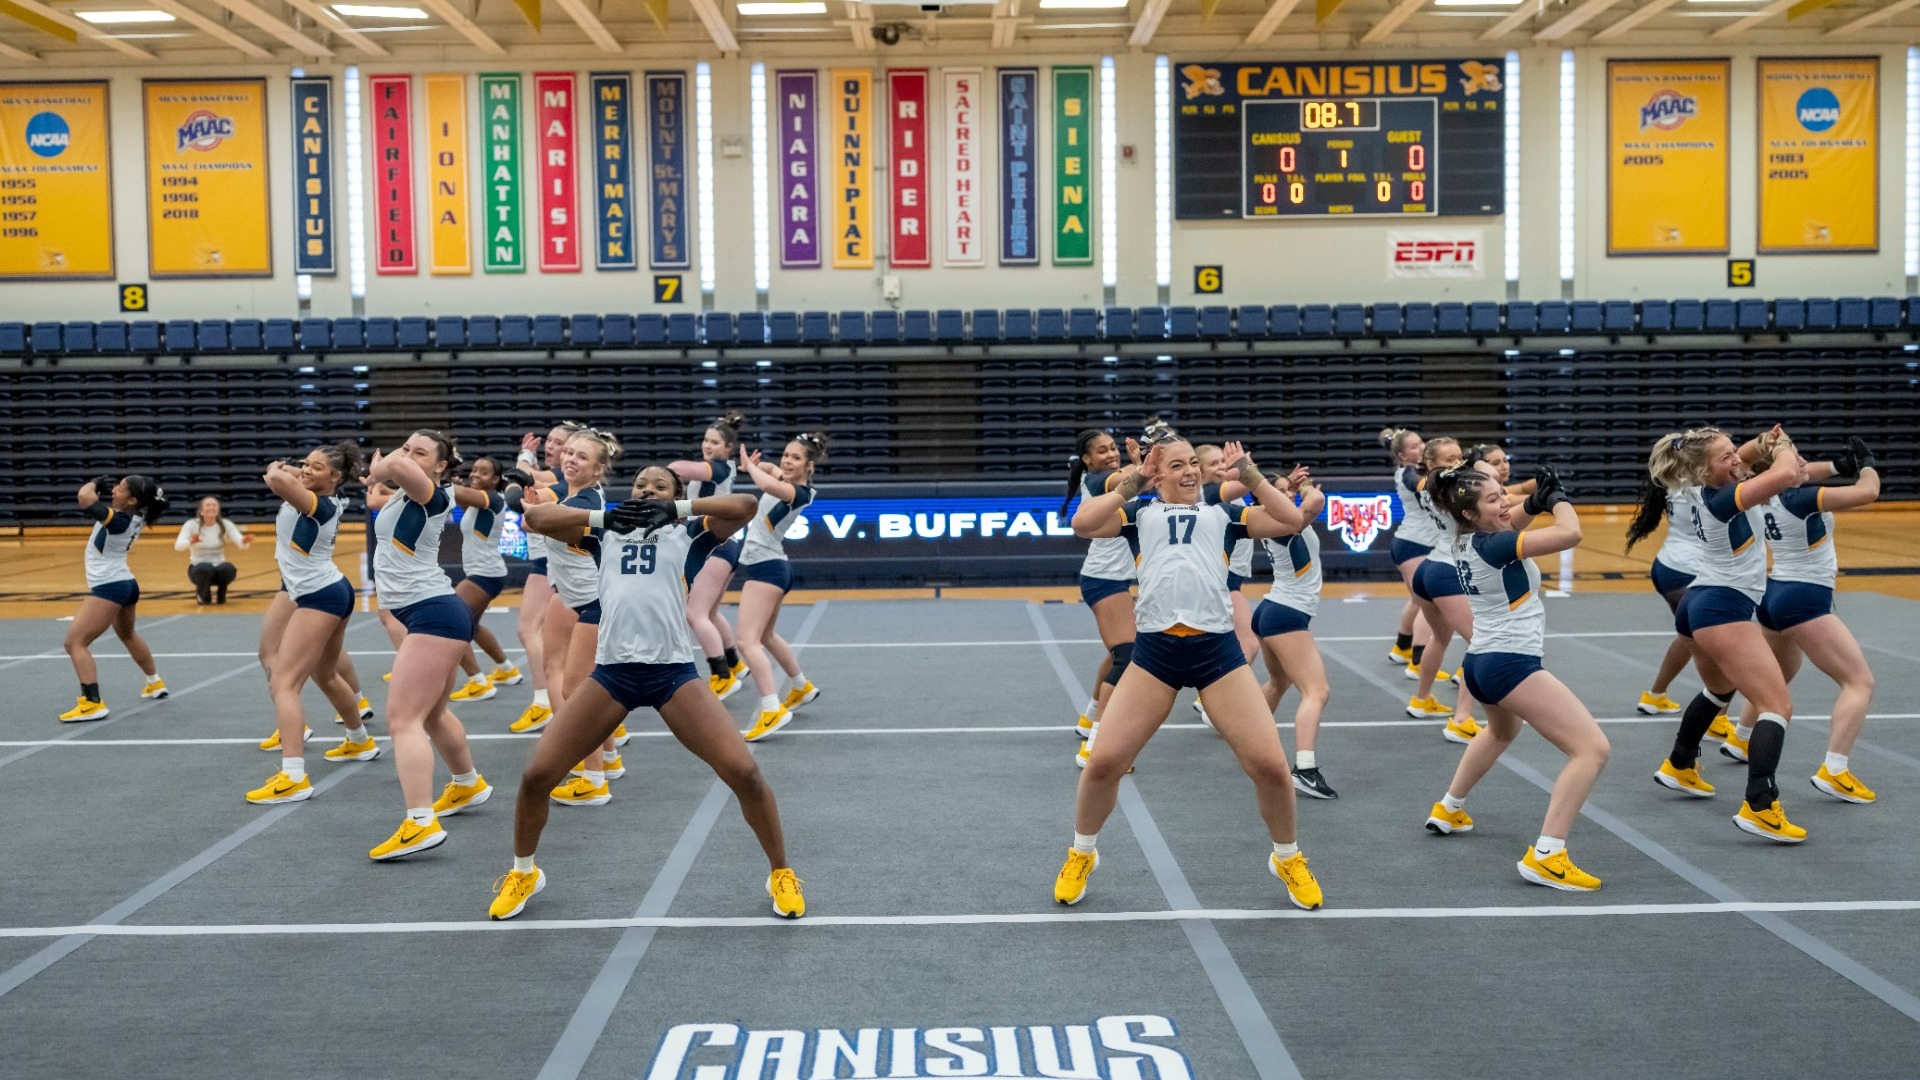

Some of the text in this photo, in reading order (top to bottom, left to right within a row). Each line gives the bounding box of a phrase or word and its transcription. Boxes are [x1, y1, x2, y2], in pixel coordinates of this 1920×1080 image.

[1237, 64, 1447, 96] CANISIUS
[656, 81, 676, 160] MOUNT
[1304, 102, 1359, 128] 08.7
[1641, 97, 1695, 129] MAAC
[1800, 108, 1839, 122] NCAA
[30, 133, 69, 147] NCAA
[177, 118, 232, 150] MAAC
[1252, 132, 1301, 145] CANISIUS
[1387, 131, 1422, 143] GUEST
[789, 94, 810, 245] NIAGARA
[844, 79, 862, 257] QUINNIPIAC
[899, 101, 919, 236] RIDER
[955, 79, 971, 255] SACRED HEART
[1009, 76, 1028, 257] SAINT PETERS
[1062, 98, 1084, 234] SIENA
[1280, 147, 1296, 173] 0
[1341, 150, 1348, 168] 1
[1408, 145, 1424, 171] 0
[1623, 155, 1663, 165] 2005
[2, 179, 36, 189] 1955
[162, 177, 198, 186] 1994
[304, 97, 325, 256] CANISIUS
[384, 86, 403, 263] FAIRFIELD
[439, 122, 457, 225] IONA
[490, 83, 513, 262] MANHATTAN
[544, 90, 568, 254] MARIST
[602, 86, 625, 257] MERRIMACK
[1769, 169, 1808, 179] 2005
[2, 195, 37, 205] 1956
[162, 193, 198, 203] 1996
[1262, 183, 1276, 204] 0
[1290, 182, 1304, 204] 0
[1377, 181, 1391, 202] 0
[1411, 181, 1424, 201] 0
[3, 211, 37, 221] 1957
[163, 209, 199, 219] 2018
[3, 227, 38, 237] 1996
[1394, 241, 1474, 262] ESPN
[1197, 267, 1220, 291] 6
[1731, 262, 1752, 285] 5
[123, 286, 146, 311] 8
[658, 278, 679, 301] 7
[822, 513, 867, 538] V.
[879, 511, 1074, 538] BUFFAL
[1167, 514, 1197, 544] 17
[620, 544, 657, 574] 29
[641, 1014, 1198, 1080] CANISIUS
